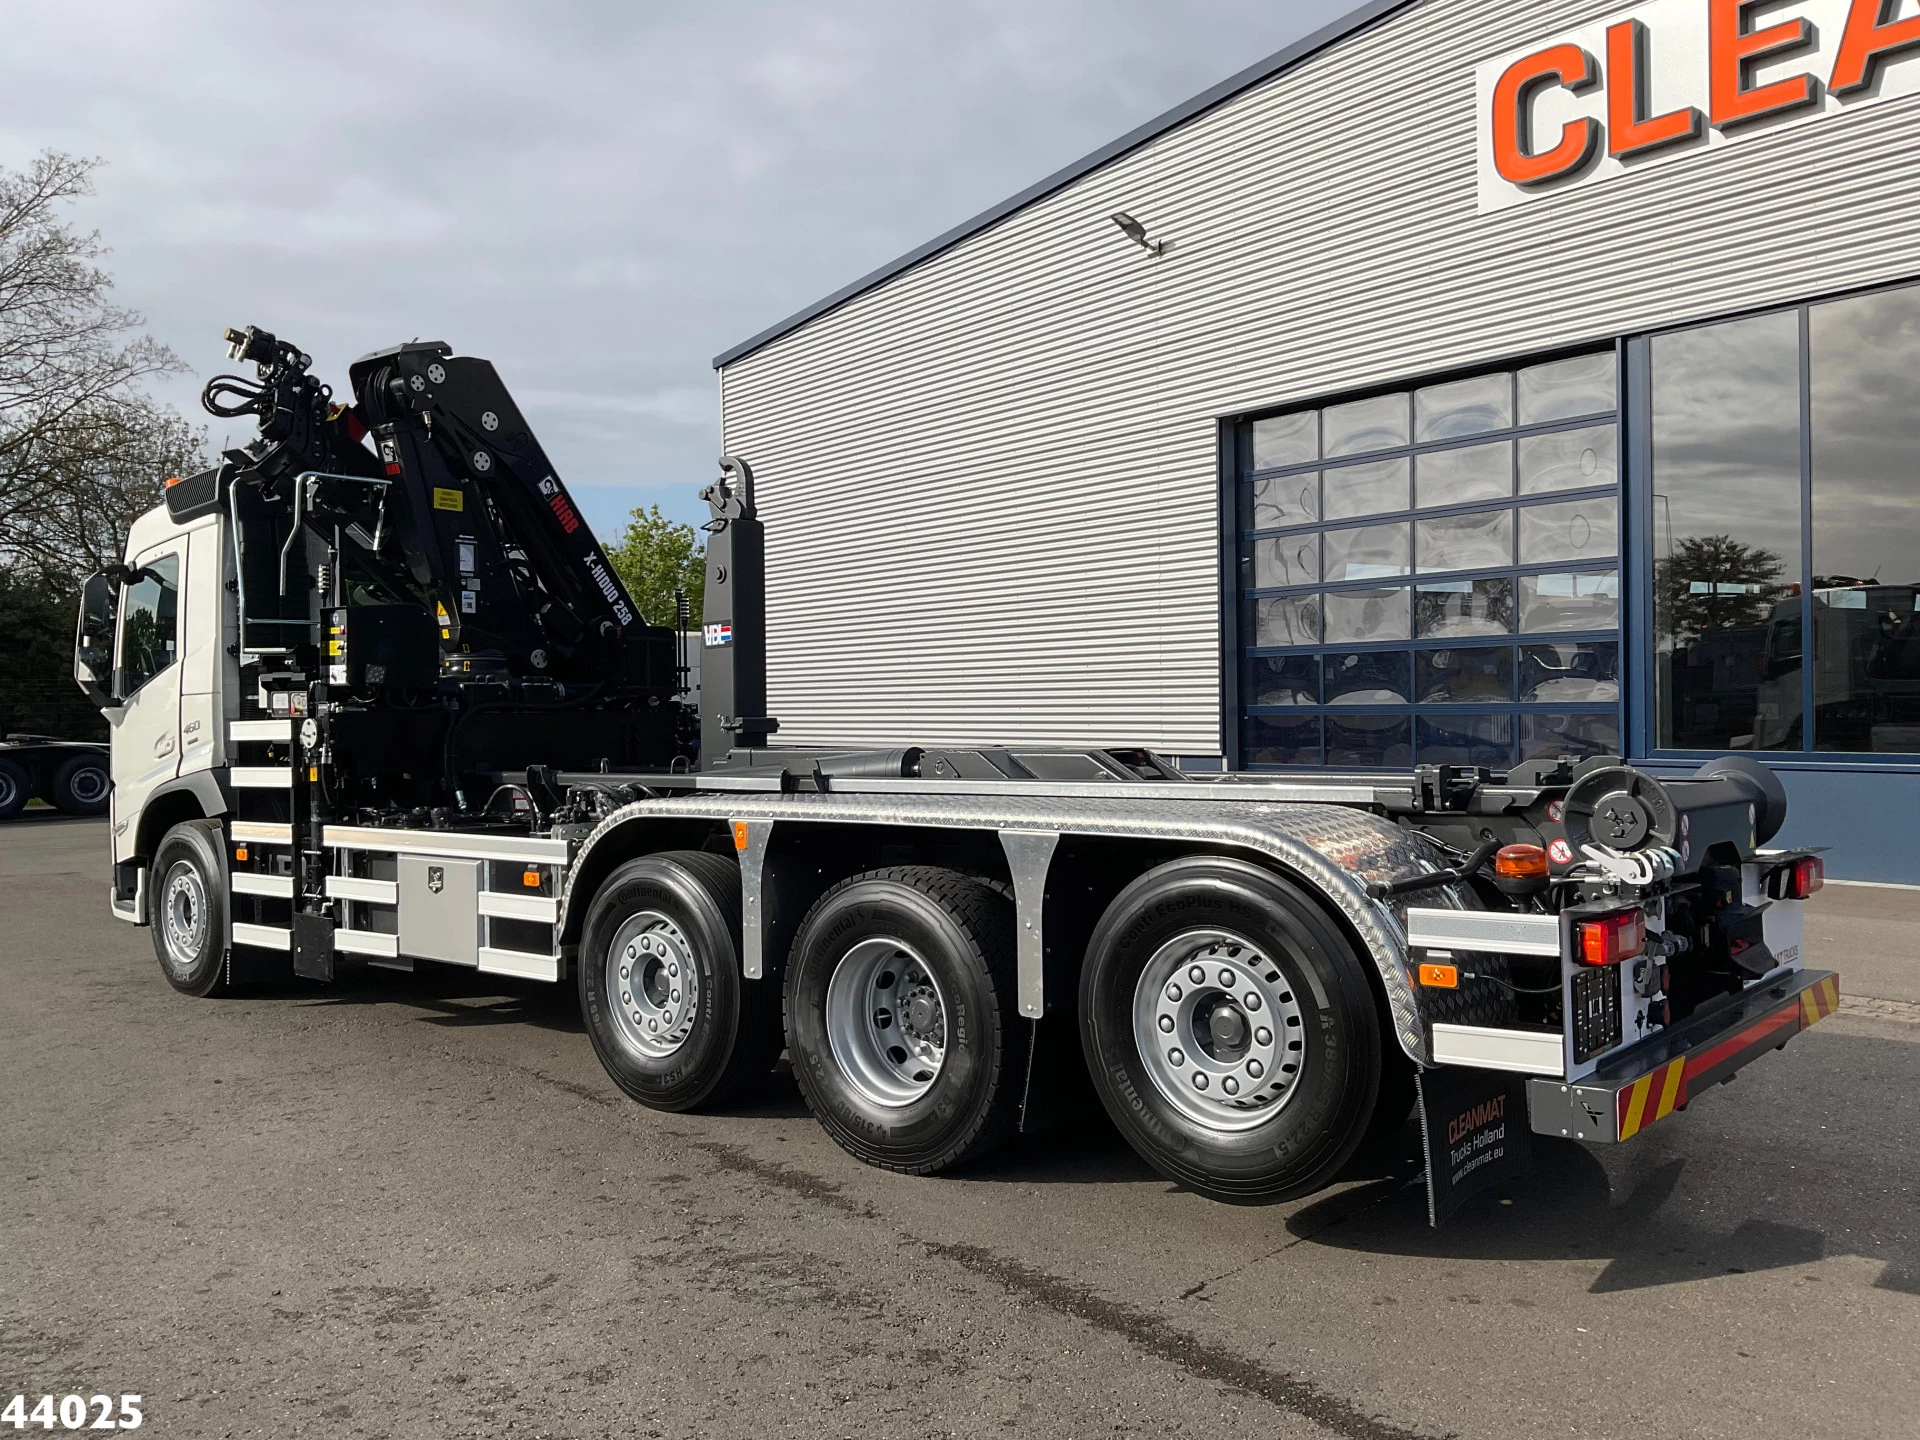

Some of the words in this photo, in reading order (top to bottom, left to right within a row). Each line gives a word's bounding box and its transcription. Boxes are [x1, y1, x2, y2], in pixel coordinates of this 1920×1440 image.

[550, 494, 579, 534] HIAB
[583, 551, 619, 603] X-HIDUO
[612, 600, 633, 626] 258
[703, 623, 726, 647] VDL
[183, 719, 201, 734] 460
[617, 886, 672, 906] Continental
[1154, 895, 1224, 919] EcoPlus
[1448, 1094, 1506, 1145] CLEANMAT
[1450, 1141, 1472, 1167] Trucks
[1473, 1122, 1505, 1152] Holland
[1451, 1146, 1504, 1186] www.cleanmat.eu
